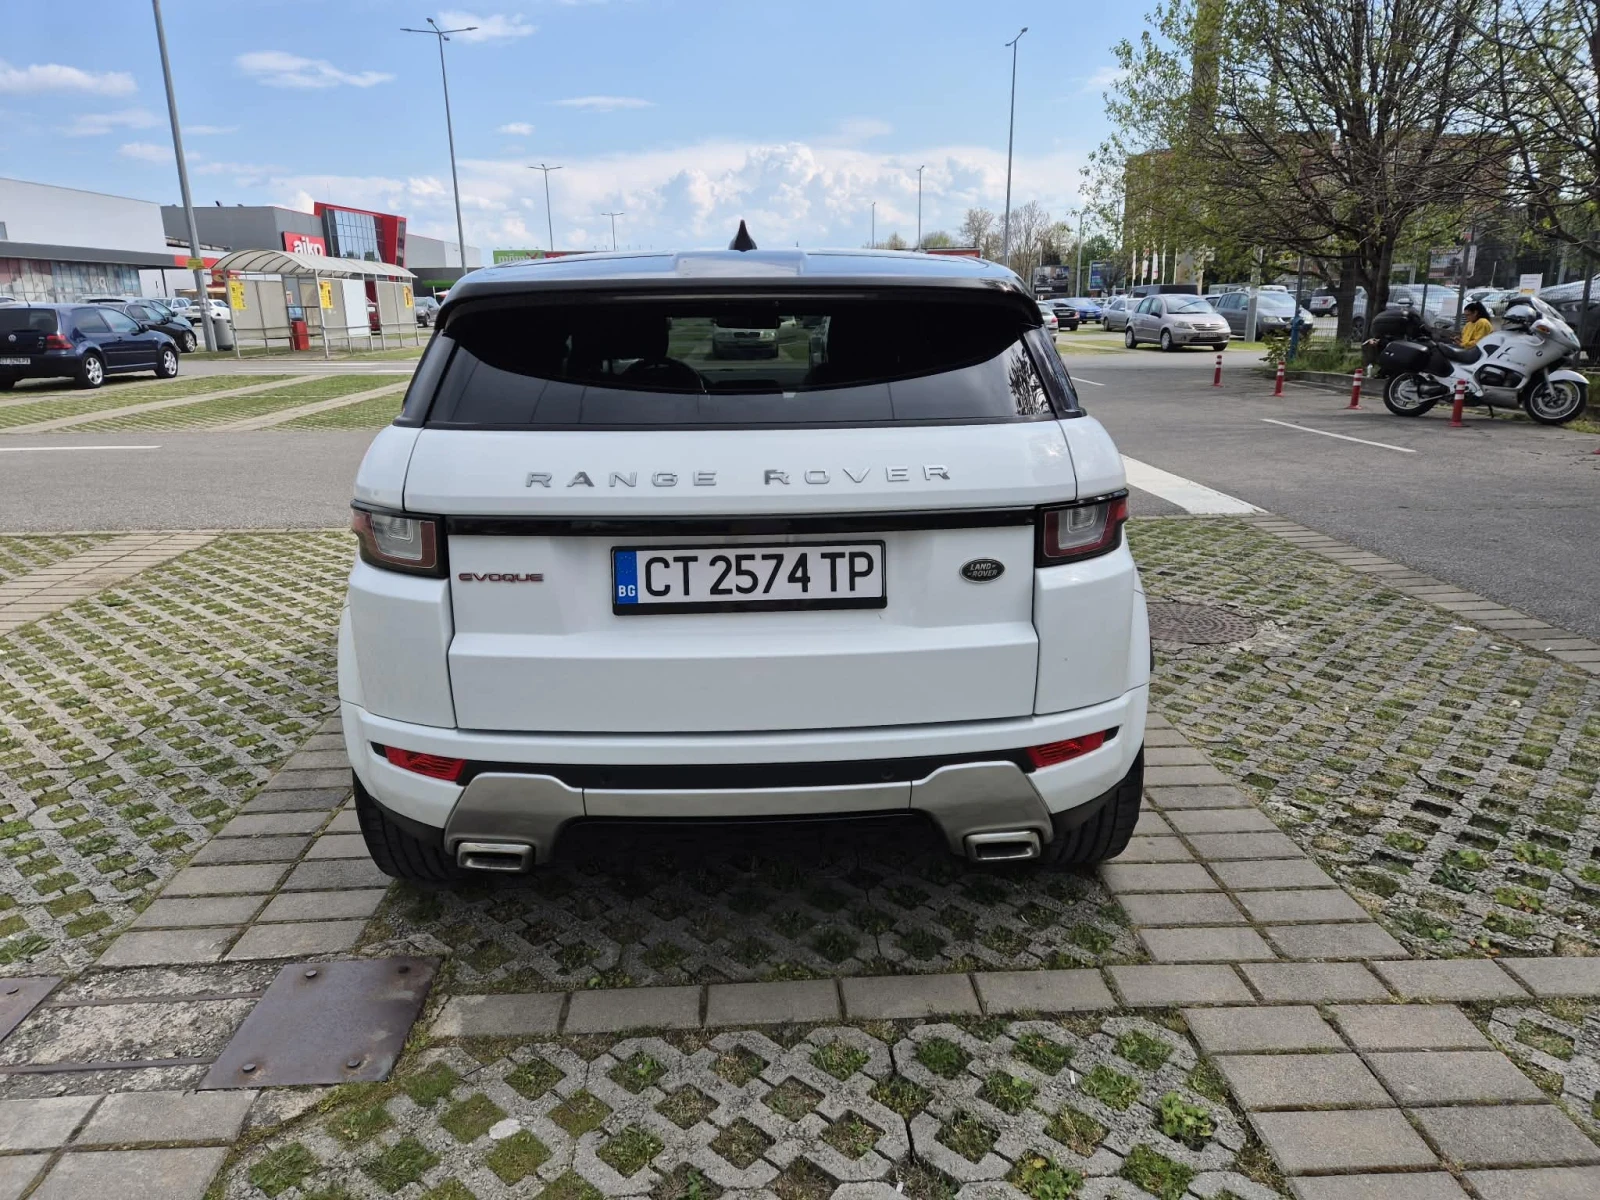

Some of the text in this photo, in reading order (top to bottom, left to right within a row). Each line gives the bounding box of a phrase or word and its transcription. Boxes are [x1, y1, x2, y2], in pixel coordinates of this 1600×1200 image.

[293, 236, 324, 256] aiko
[525, 465, 951, 488] RANGE ROVER
[970, 563, 992, 571] LAND
[458, 573, 544, 583] EVOQUE
[645, 551, 875, 597] CT 2574 TP
[972, 569, 998, 578] ROVER
[618, 585, 636, 597] BG
